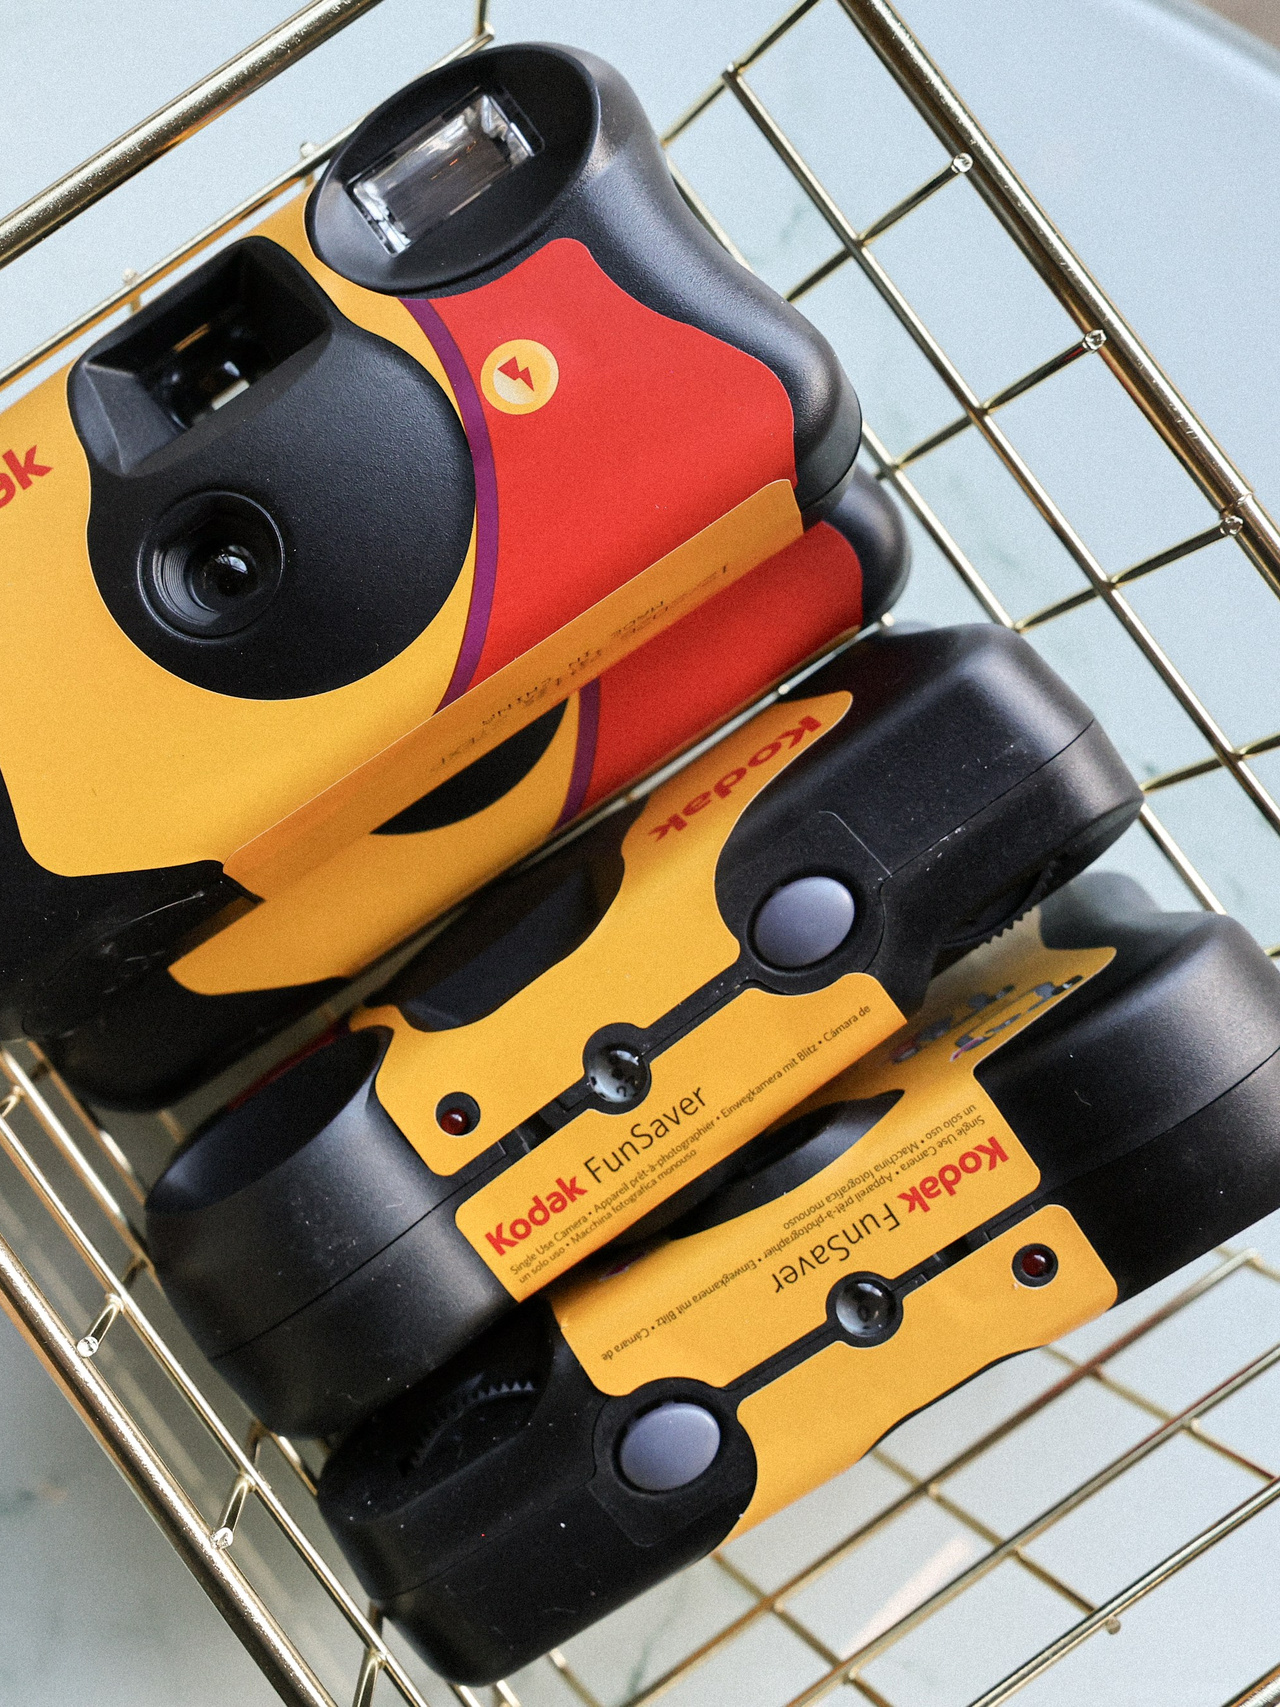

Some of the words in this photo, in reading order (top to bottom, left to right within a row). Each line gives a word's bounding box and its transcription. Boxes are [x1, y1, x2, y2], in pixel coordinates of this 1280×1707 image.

[649, 716, 822, 842] Kodak
[942, 1112, 964, 1129] solo
[955, 1114, 986, 1137] Single
[962, 1104, 977, 1116] un
[509, 1253, 538, 1276] Single
[534, 1240, 555, 1256] Use
[553, 1215, 589, 1242] Camera
[593, 1181, 630, 1214] Appareil
[629, 1119, 716, 1189] prêt-à-photographier
[720, 1070, 783, 1119] Einwegkamera
[782, 1057, 799, 1073] mit
[796, 1043, 819, 1062] Blitz
[822, 1014, 859, 1042] Cámara
[858, 1005, 871, 1018] de
[924, 1125, 944, 1140] uso
[936, 1133, 958, 1149] Use
[484, 1176, 588, 1257] Kodak
[583, 1086, 706, 1184] FunSaver
[873, 1140, 920, 1173] Macchina
[899, 1145, 938, 1172] Camera
[824, 1169, 876, 1204] fotografica
[854, 1171, 893, 1203] Appareil
[896, 1135, 1009, 1214] Kodak
[518, 1272, 532, 1284] un
[530, 1259, 550, 1276] solo
[548, 1246, 566, 1262] uso
[570, 1211, 613, 1245] Macchina
[610, 1178, 658, 1214] fotografica
[656, 1149, 697, 1181] monouso
[763, 1195, 855, 1259] prêt-à-photographier
[782, 1199, 826, 1230] monouso
[771, 1202, 901, 1294] FunSaver
[691, 1259, 758, 1304] Einwegkamera
[654, 1310, 678, 1327] Blitz
[675, 1299, 693, 1315] mit
[600, 1349, 614, 1361] de
[613, 1327, 650, 1353] Cámara
